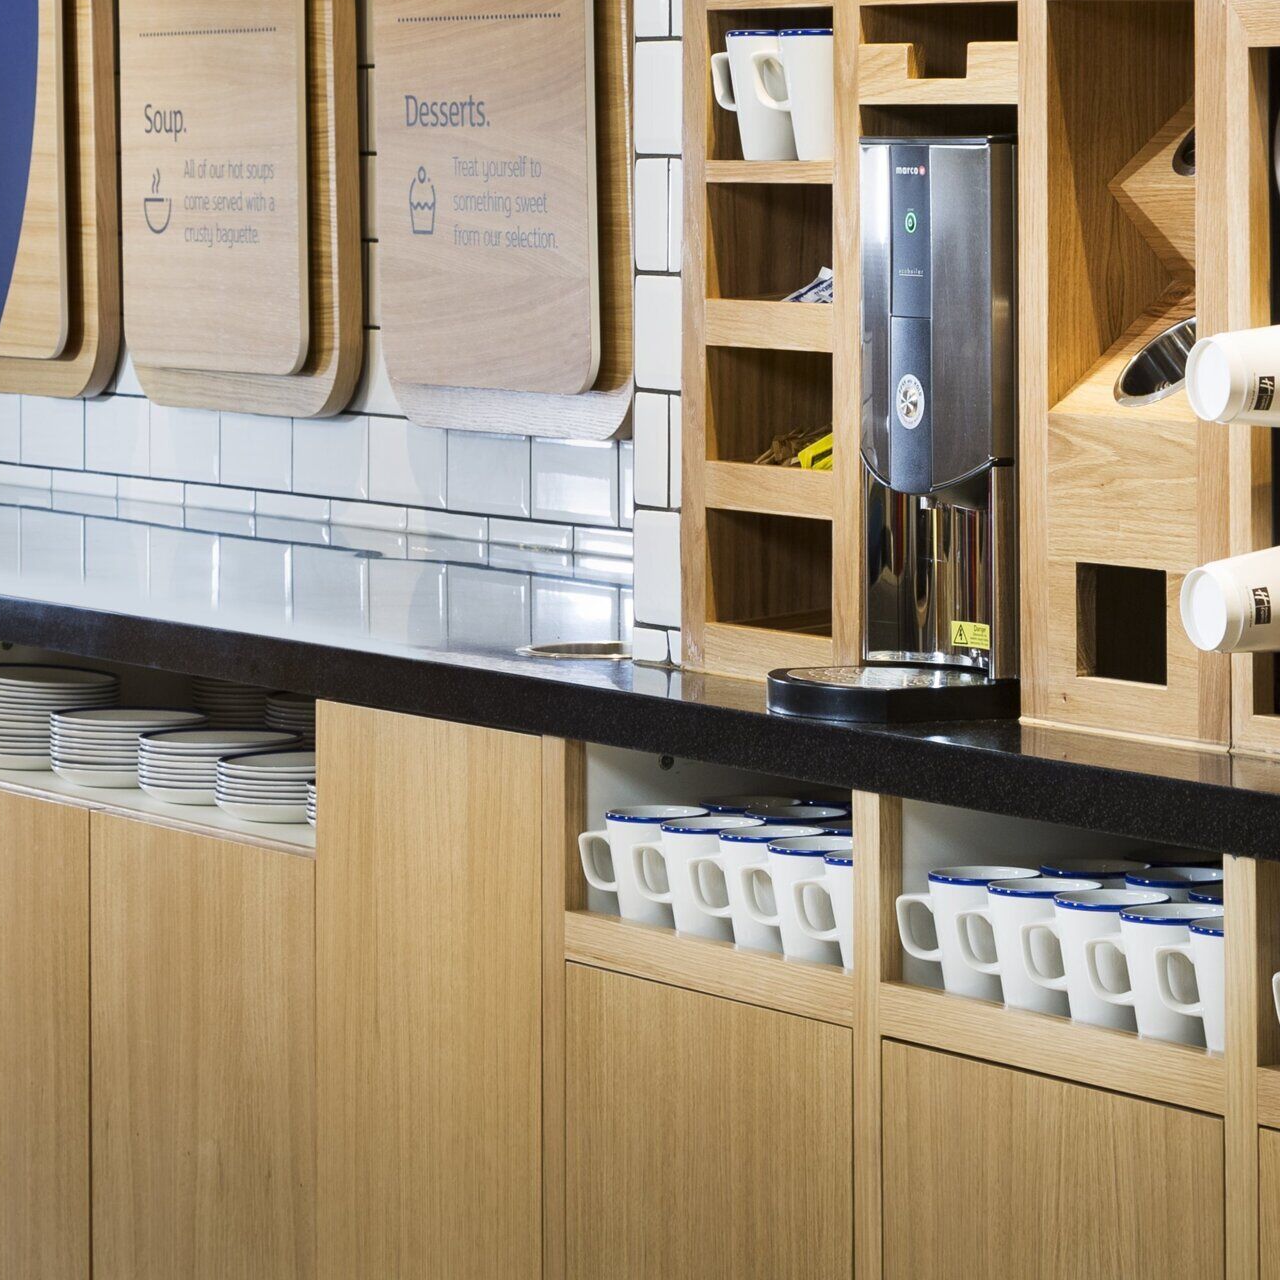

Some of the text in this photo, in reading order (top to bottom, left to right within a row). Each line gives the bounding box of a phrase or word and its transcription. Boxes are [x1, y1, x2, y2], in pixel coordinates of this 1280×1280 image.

[144, 104, 187, 142] Soup.
[404, 95, 490, 127] Desserts.
[184, 159, 274, 184] All of our hot soups
[452, 156, 542, 182] Treat yourself to
[896, 166, 918, 174] marco
[184, 192, 275, 212] come served with a
[453, 191, 548, 218] something sweet
[184, 226, 214, 248] crusty
[454, 224, 558, 248] from our selection.
